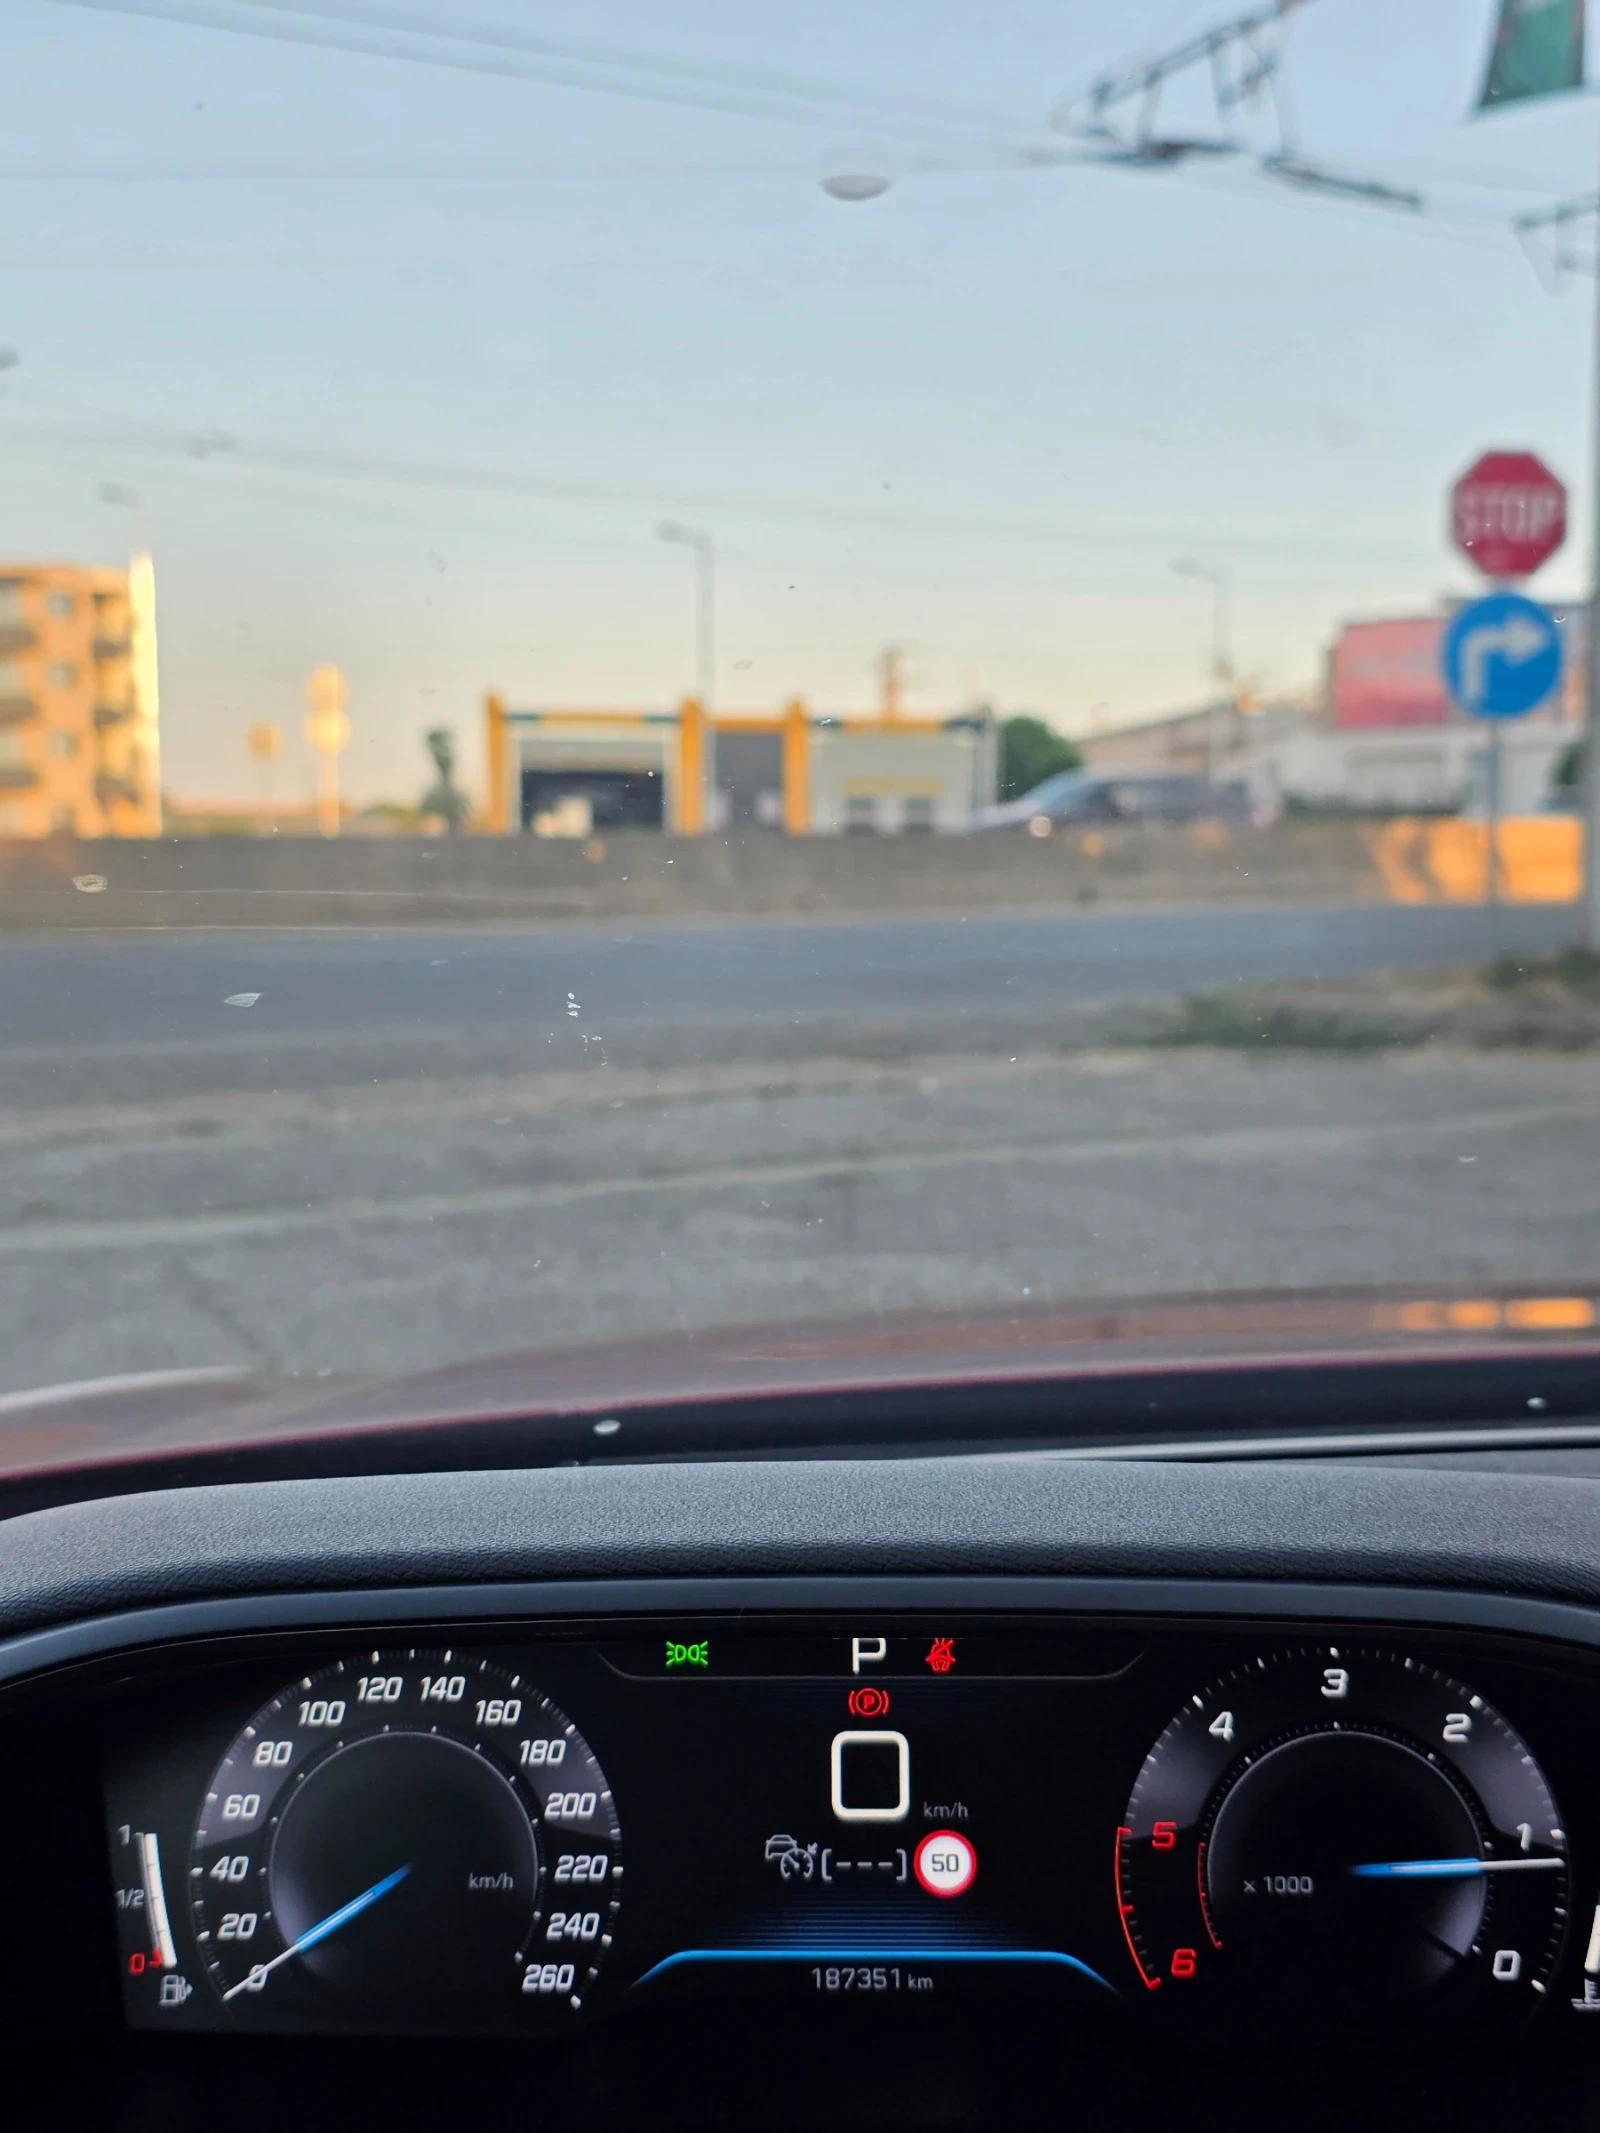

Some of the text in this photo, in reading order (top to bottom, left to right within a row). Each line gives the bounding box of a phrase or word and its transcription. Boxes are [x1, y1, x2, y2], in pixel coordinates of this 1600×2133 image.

[1459, 486, 1557, 541] STOP
[852, 1638, 886, 1674] P
[358, 1676, 403, 1702] 120
[421, 1675, 466, 1701] 140
[1321, 1668, 1348, 1697] 3
[299, 1700, 346, 1726] 100
[476, 1699, 521, 1725] 160
[1208, 1711, 1234, 1742] 4
[1442, 1713, 1472, 1743] 2
[254, 1741, 293, 1766] 80
[520, 1739, 566, 1765] 180
[831, 1731, 910, 1821] 0
[223, 1793, 261, 1818] 60
[544, 1792, 596, 1818] 200
[923, 1801, 969, 1818] km/h
[118, 1825, 131, 1847] 1
[1152, 1821, 1177, 1849] 5
[1516, 1823, 1533, 1851] 1
[210, 1856, 250, 1882] 40
[554, 1855, 608, 1881] 220
[931, 1854, 960, 1873] 50
[468, 1871, 514, 1889] km/h
[1263, 1876, 1313, 1894] 1000
[116, 1888, 146, 1908] 1/2
[217, 1913, 258, 1939] 20
[546, 1912, 600, 1939] 240
[128, 1953, 146, 1975] 0
[1171, 1949, 1197, 1977] 6
[1492, 1949, 1521, 1980] 0
[522, 1964, 575, 1990] 260
[811, 1967, 934, 1990] 187351 km
